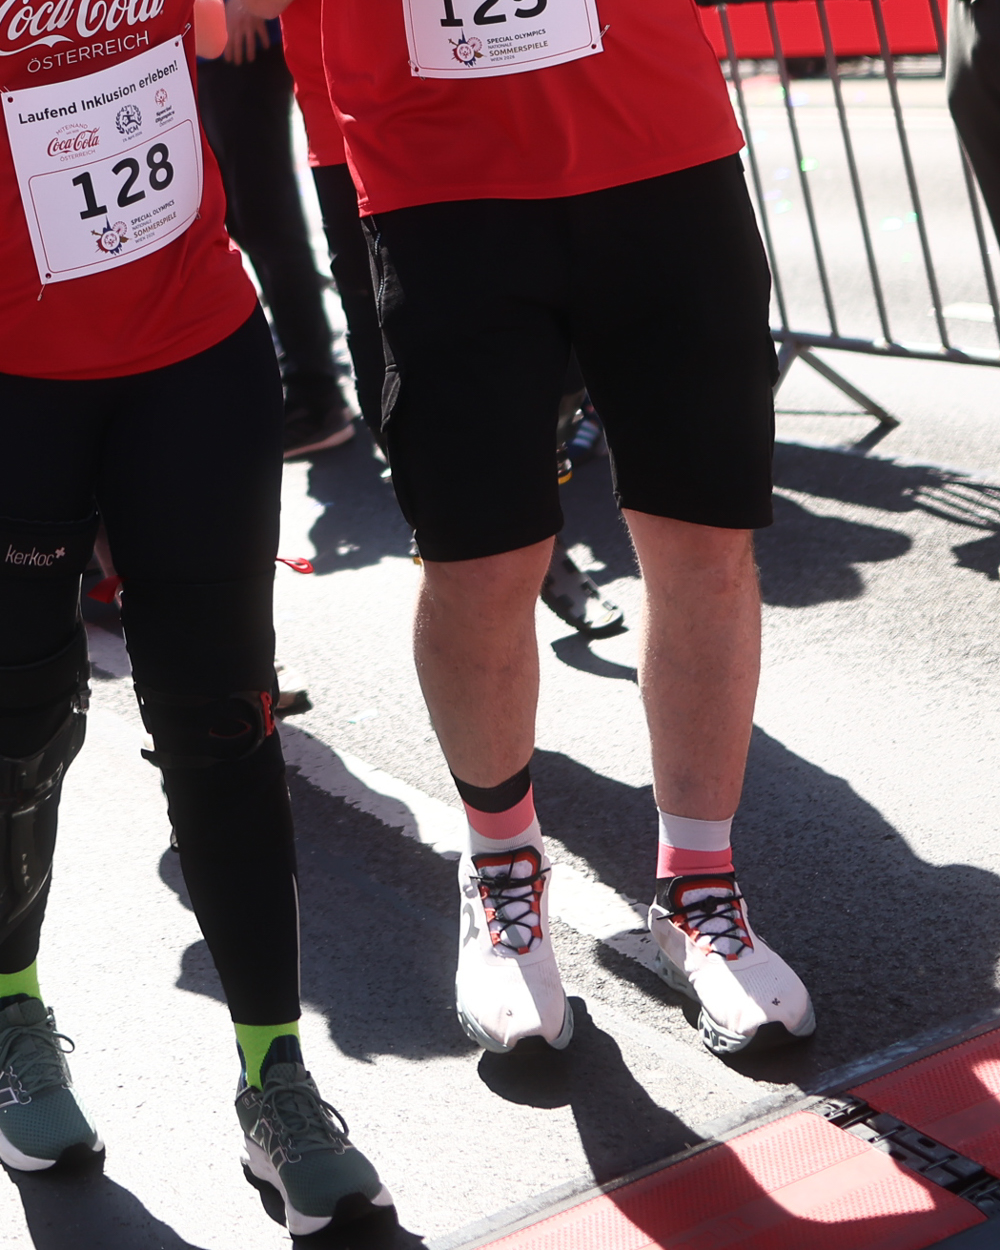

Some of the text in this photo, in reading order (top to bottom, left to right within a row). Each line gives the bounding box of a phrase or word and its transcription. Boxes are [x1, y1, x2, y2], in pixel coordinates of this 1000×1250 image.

[487, 29, 546, 44] SPECIAL OLYMPICS
[489, 41, 548, 57] SOMMERSPIELE
[27, 31, 149, 73] ÖSTERREICH
[18, 60, 179, 125] Laufend Inklusion erleben!
[47, 127, 100, 157] Coca-Cola
[126, 125, 139, 135] VCM
[60, 149, 96, 161] ÖSTERREICH
[72, 143, 174, 220] 128
[131, 199, 175, 226] SPECIAL OLYMPICS
[133, 211, 177, 238] SOMMERSPIELE
[5, 544, 54, 566] kerkoc
